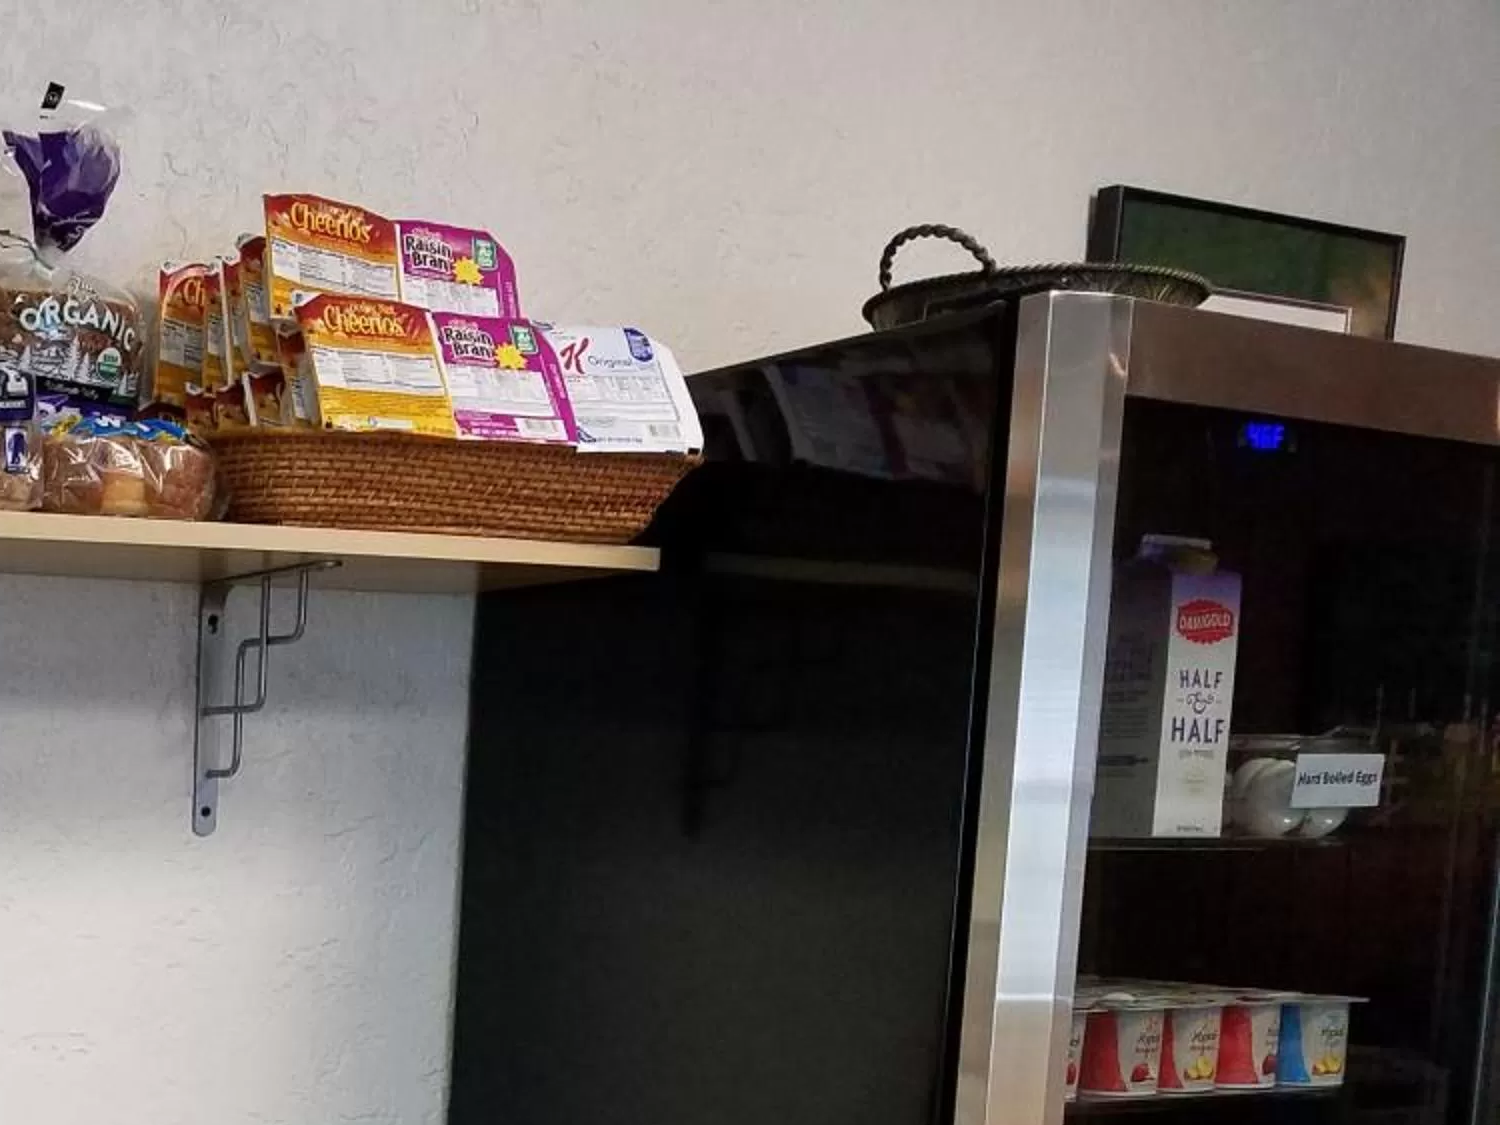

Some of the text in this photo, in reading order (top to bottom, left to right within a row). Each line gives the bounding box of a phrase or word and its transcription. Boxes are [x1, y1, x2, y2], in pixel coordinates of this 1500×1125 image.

[290, 202, 373, 243] Cheerios
[405, 235, 451, 258] Raisin
[412, 252, 449, 273] Bran
[19, 299, 136, 351] ORGANIC
[324, 304, 406, 337] Cheerios
[444, 327, 493, 346] Raisin
[454, 342, 492, 358] Bran
[560, 337, 590, 375] K
[1179, 668, 1224, 689] HALF
[1171, 716, 1225, 744] HALF
[1298, 770, 1379, 786] Hard Boiled Eggs
